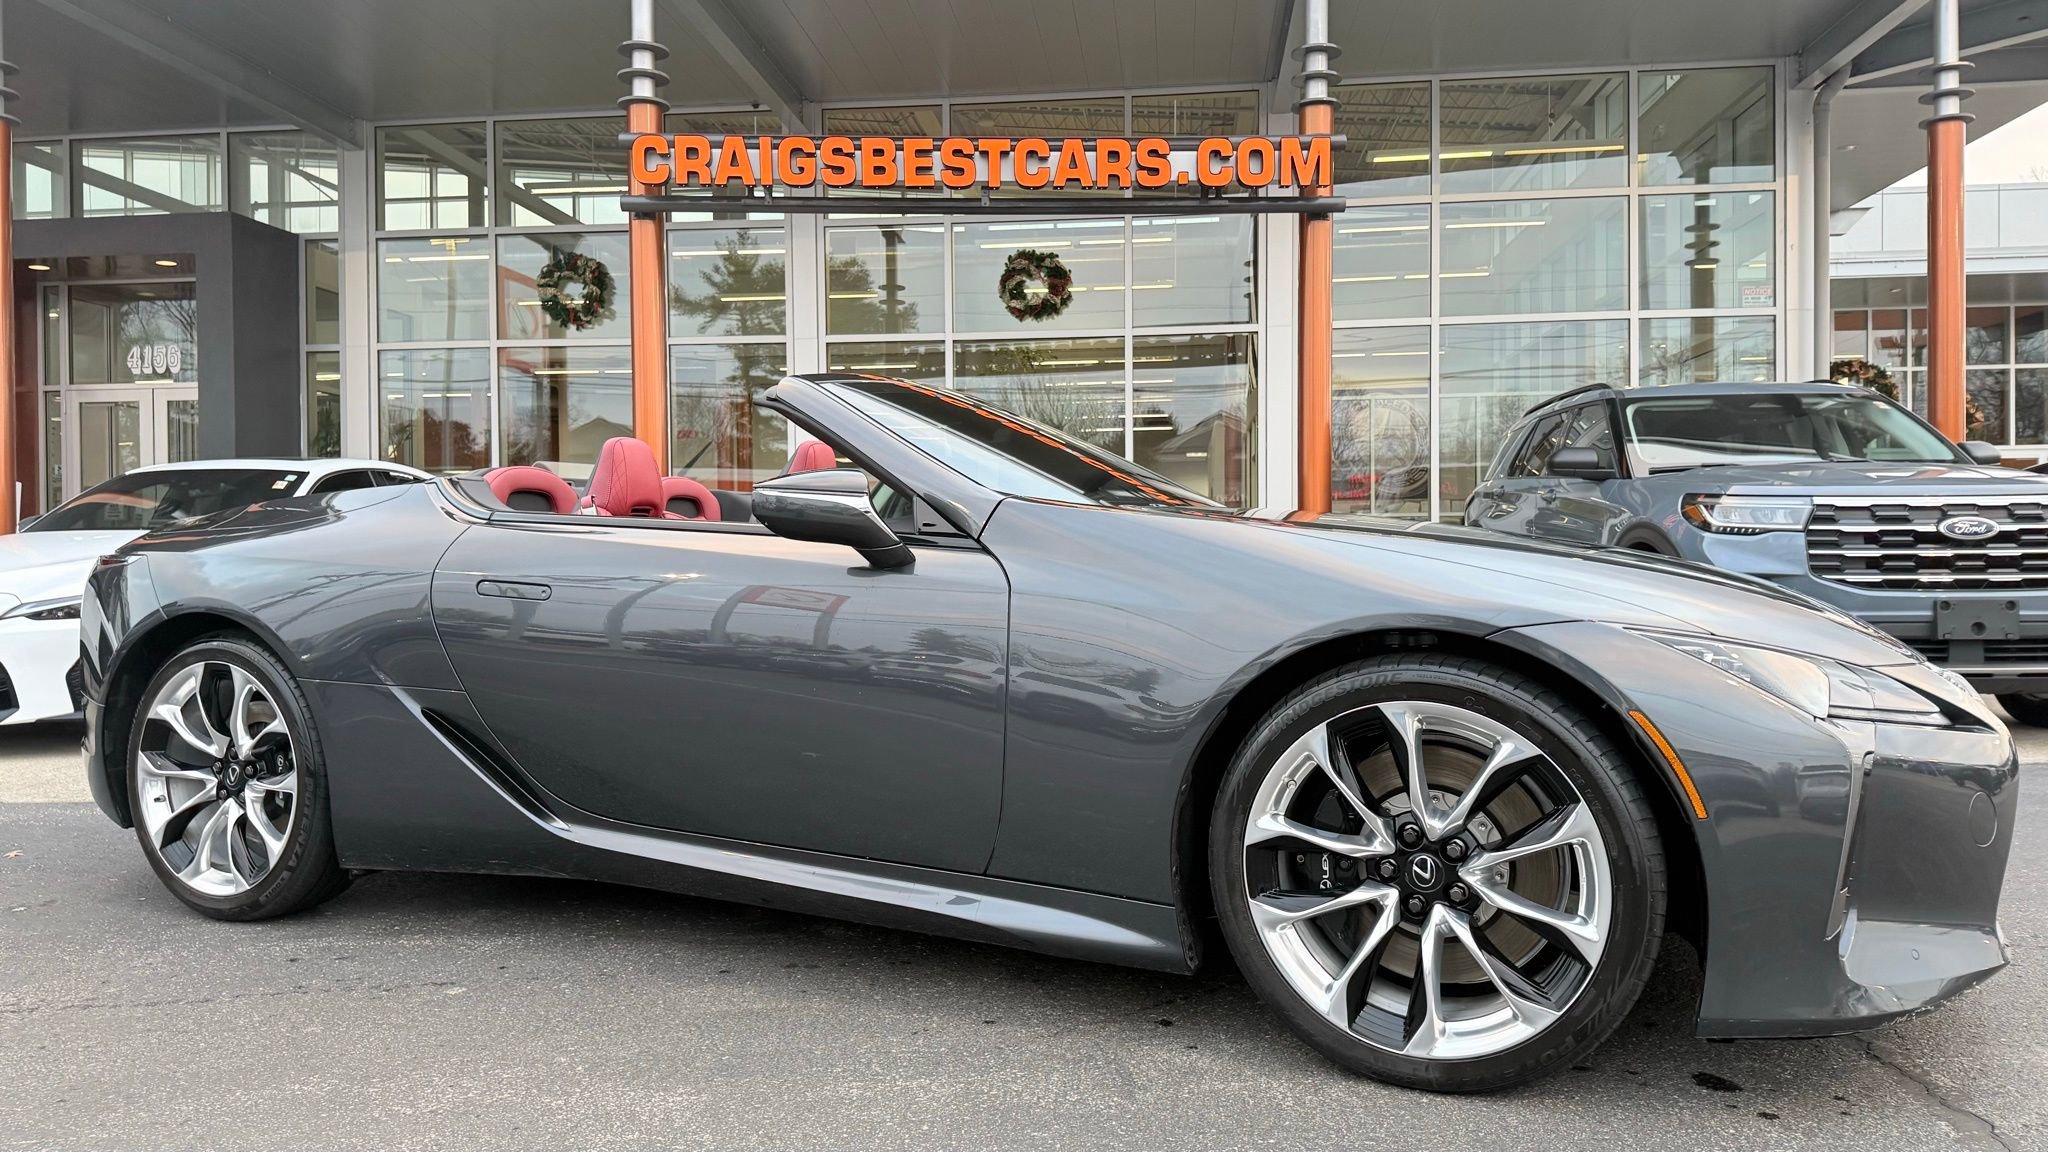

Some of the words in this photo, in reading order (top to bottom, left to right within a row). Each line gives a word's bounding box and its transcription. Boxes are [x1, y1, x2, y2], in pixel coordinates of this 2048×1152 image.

[631, 134, 1331, 187] CRAIGSBESTCARS.COM
[127, 345, 181, 375] 4156
[1953, 520, 1988, 534] Ford
[1268, 671, 1404, 742] BRIDGESTONE
[288, 776, 314, 867] POTENZA
